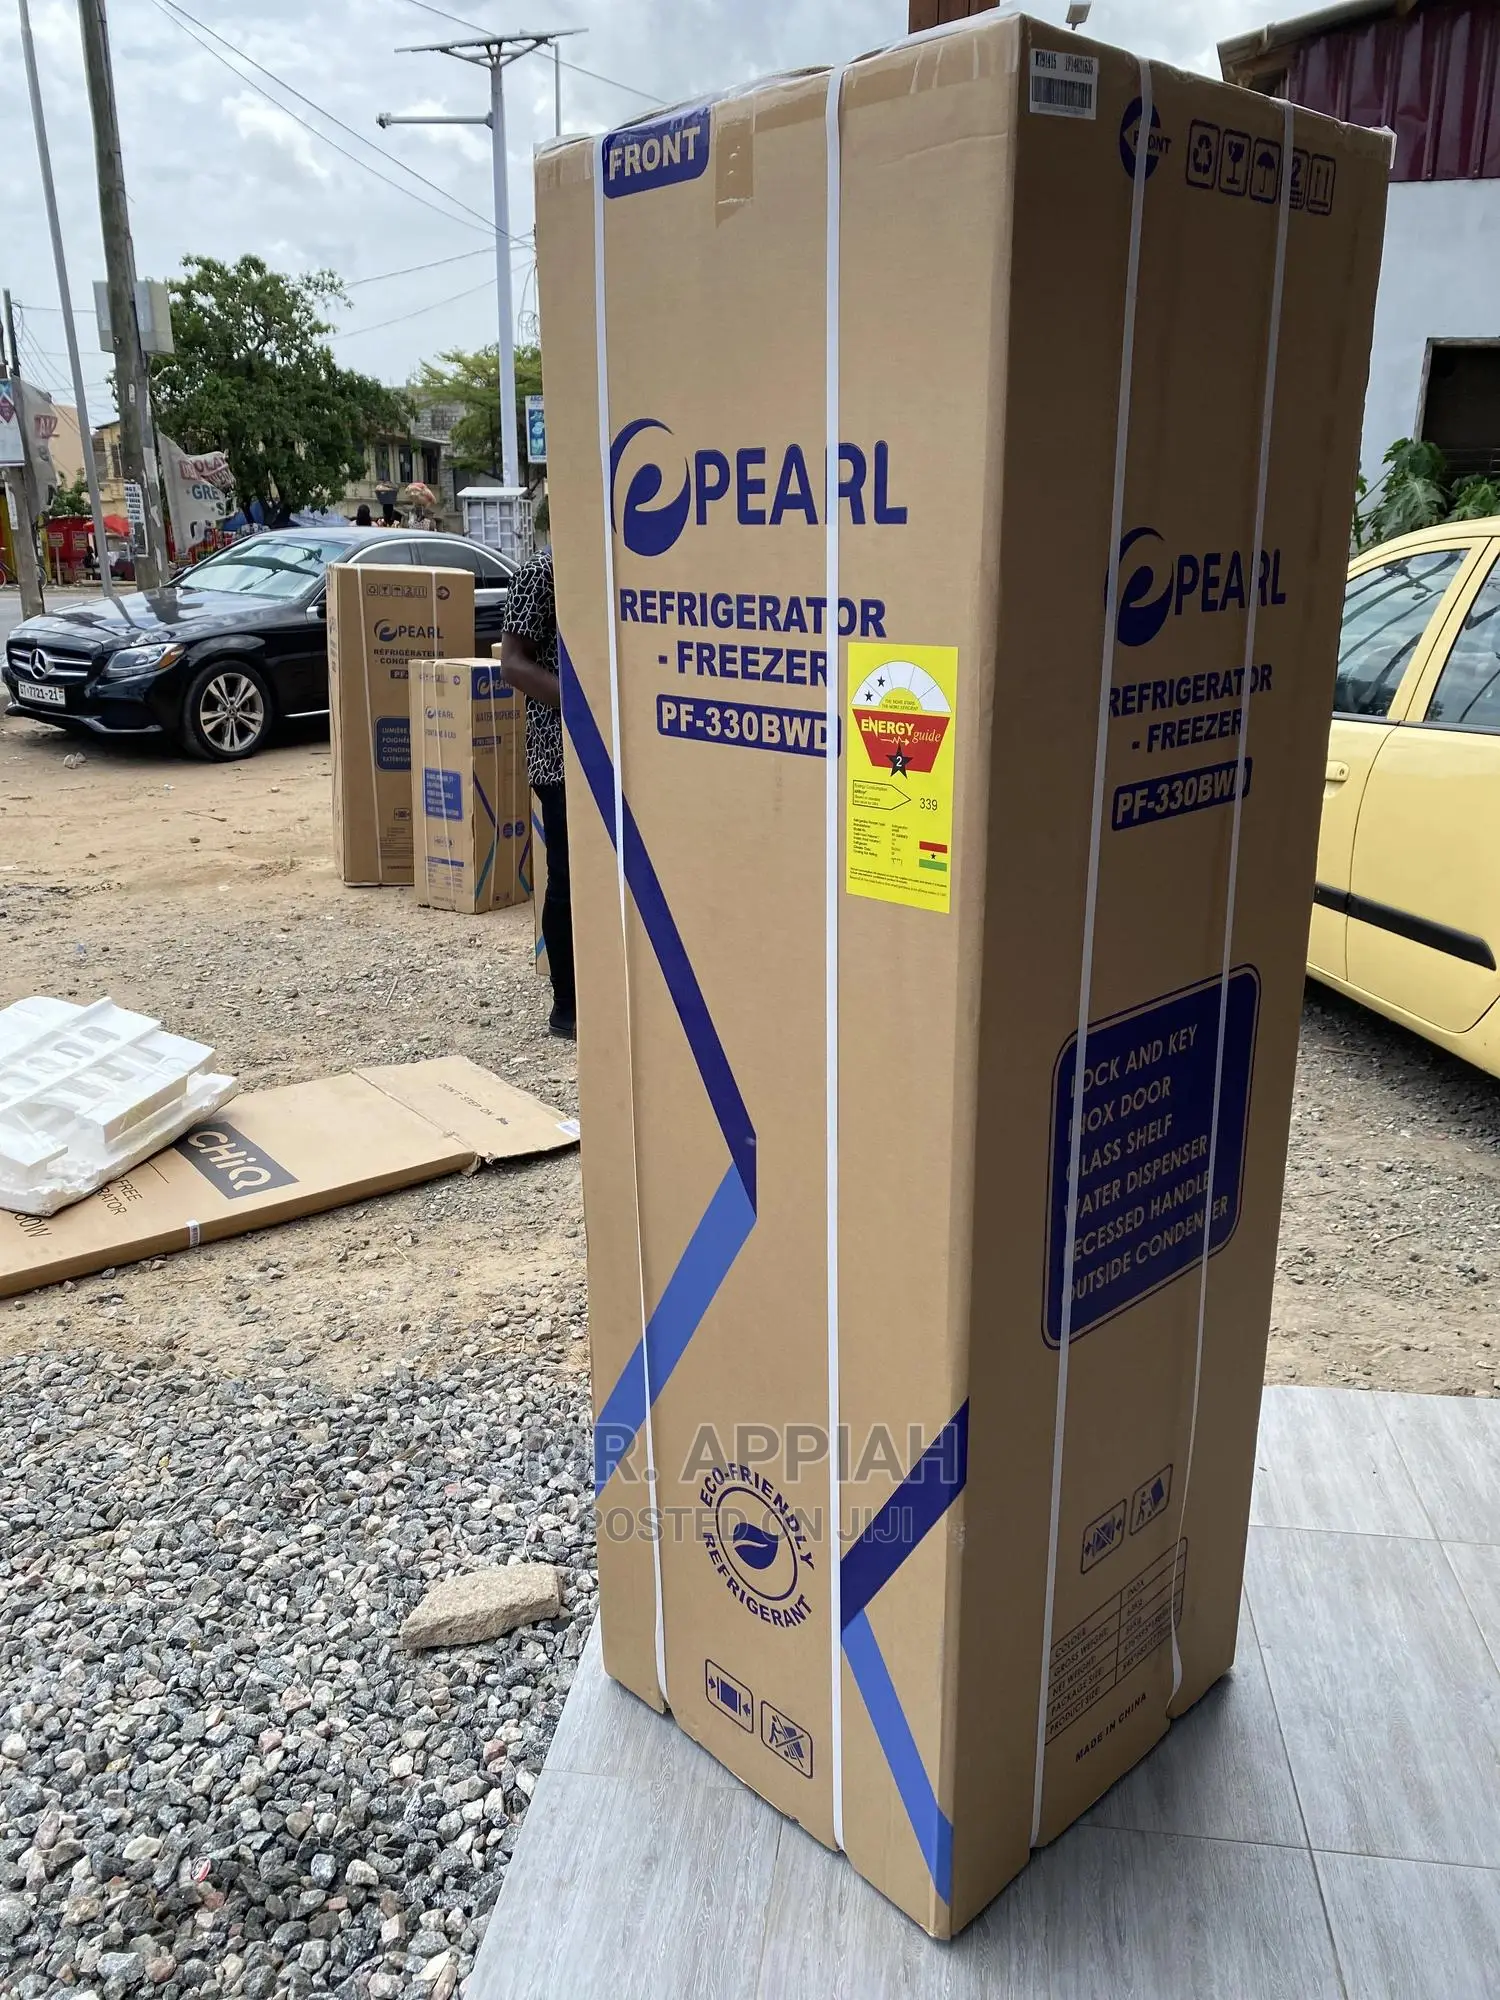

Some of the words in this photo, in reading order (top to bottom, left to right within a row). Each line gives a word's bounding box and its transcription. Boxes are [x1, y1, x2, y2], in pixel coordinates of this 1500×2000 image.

[608, 127, 701, 181] FRONT
[1133, 130, 1172, 154] FONT
[695, 440, 908, 525] PEARL
[1174, 548, 1286, 615] PEARL
[398, 625, 445, 640] PEARL
[620, 588, 887, 638] REFRIGERATOR
[677, 640, 828, 687] FREEZER
[1108, 664, 1273, 718] REFRIGERATOR
[861, 716, 915, 737] ENERGY
[912, 729, 942, 744] guide
[896, 755, 903, 767] 2
[919, 797, 938, 811] 339
[1125, 1039, 1163, 1075] AND
[1168, 1023, 1198, 1056] KEY
[1120, 1076, 1171, 1118] DOOR
[1066, 1138, 1121, 1182] LASS
[1127, 1114, 1172, 1154] SHELF
[1127, 1135, 1208, 1194] DISPENSER
[1064, 1206, 1145, 1267] ECESSED
[1150, 1169, 1210, 1220] HANDLE
[1136, 1196, 1229, 1265] CONDENER
[700, 1462, 815, 1571] ECO-FRIENDLY
[703, 1532, 813, 1629] REFRIGERANT
[1075, 1731, 1103, 1763] MADE
[1105, 1720, 1116, 1736] IN
[1118, 1692, 1147, 1725] CHINA
